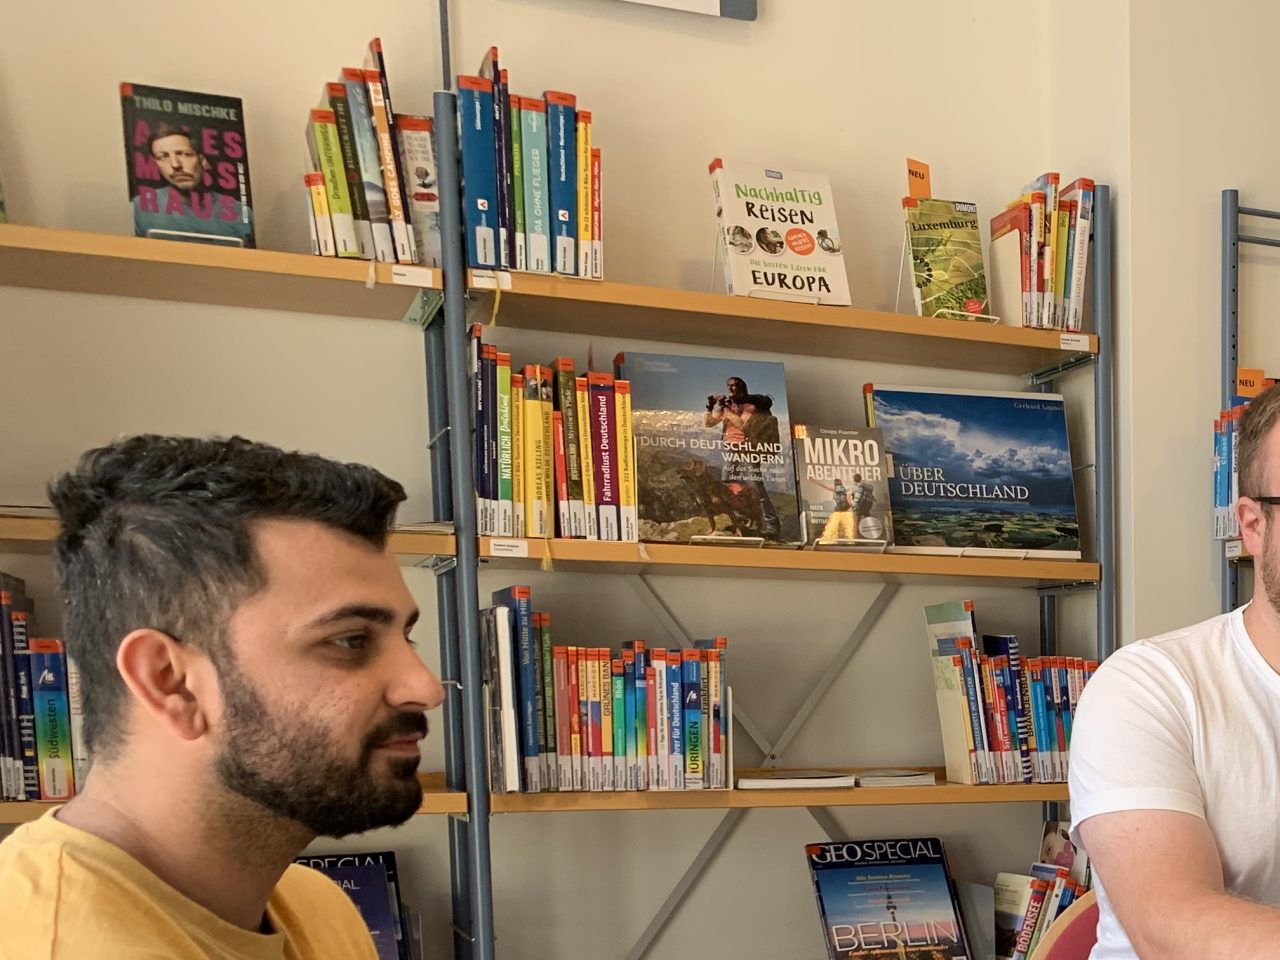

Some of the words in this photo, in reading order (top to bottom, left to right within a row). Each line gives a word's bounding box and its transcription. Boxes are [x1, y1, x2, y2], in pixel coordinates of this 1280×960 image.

[134, 95, 173, 112] THILO
[177, 101, 237, 121] MISCHKE
[133, 120, 244, 158] AES
[318, 123, 337, 166] UNTERWEG
[380, 132, 396, 177] CAMPING
[133, 152, 237, 189] MS
[531, 149, 541, 187] FLIEGER
[908, 168, 925, 180] NEU
[137, 185, 238, 223] RAUS
[533, 188, 542, 216] OHNE
[955, 202, 977, 213] DUMONT
[912, 219, 978, 232] Luxemburg
[1077, 226, 1087, 270] LUXEMBURG
[751, 270, 831, 293] EUROPA
[1239, 378, 1255, 388] NEU
[1013, 401, 1041, 410] Gerhard
[598, 395, 608, 450] Deutschland
[533, 440, 542, 470] KIELING
[640, 436, 686, 448] DURCH
[690, 439, 783, 453] DEUTSCHLAND
[803, 437, 879, 466] MIKRO
[502, 436, 511, 480] NATÜRLICH
[721, 452, 784, 465] WANDERN
[722, 465, 735, 473] Auf
[600, 454, 611, 502] Fahrradlust
[766, 476, 786, 484] Tieren
[806, 465, 881, 481] ABENTEUER
[899, 463, 945, 482] ÜBER
[901, 481, 1029, 500] DEUTSCHLAND
[521, 625, 530, 647] Hütte
[522, 648, 530, 665] Von
[603, 661, 611, 681] BAN
[603, 681, 611, 717] GRÜNES
[671, 682, 680, 727] Deutschland
[1021, 667, 1034, 737] BRANDENBUR
[49, 698, 60, 759] Südwesten
[672, 728, 681, 741] für
[1003, 736, 1011, 750] Sylt
[863, 841, 941, 861] SPECIAL
[832, 919, 958, 952] BERLIN
[1017, 899, 1042, 953] BODENSEE
